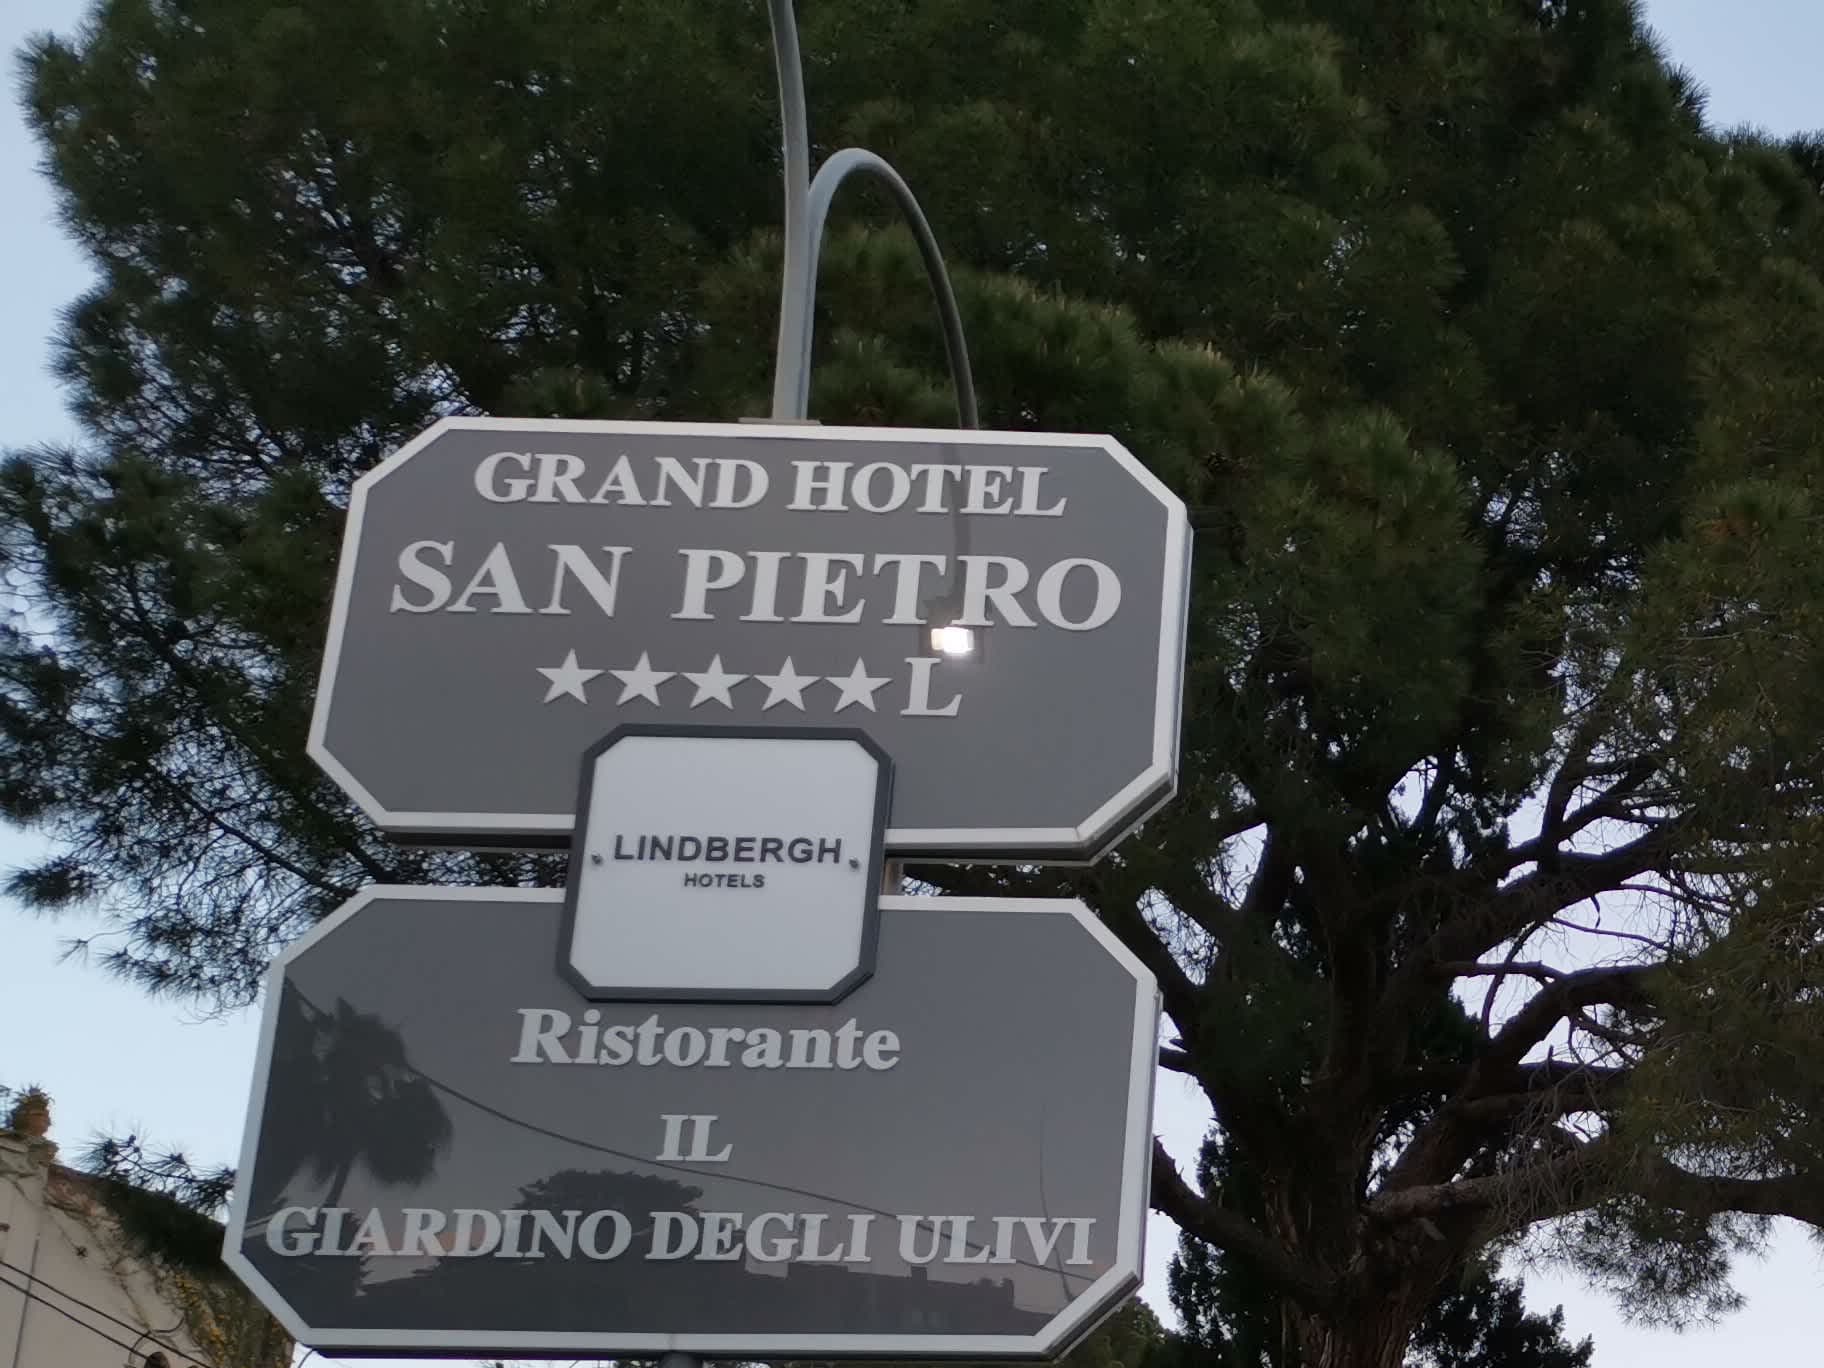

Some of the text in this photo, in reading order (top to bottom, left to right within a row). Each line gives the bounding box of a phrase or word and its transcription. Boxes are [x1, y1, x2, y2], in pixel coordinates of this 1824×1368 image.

[473, 450, 1068, 518] GRAND HOTEL
[389, 539, 1124, 632] SAN PIETRO
[900, 656, 963, 717] L
[612, 833, 843, 865] LINDBERGH
[682, 872, 766, 890] HOTELS
[508, 1007, 902, 1071] Ristorante
[654, 1113, 734, 1163] IL
[264, 1205, 1098, 1267] GIARDINO DEGLI ULIVI
